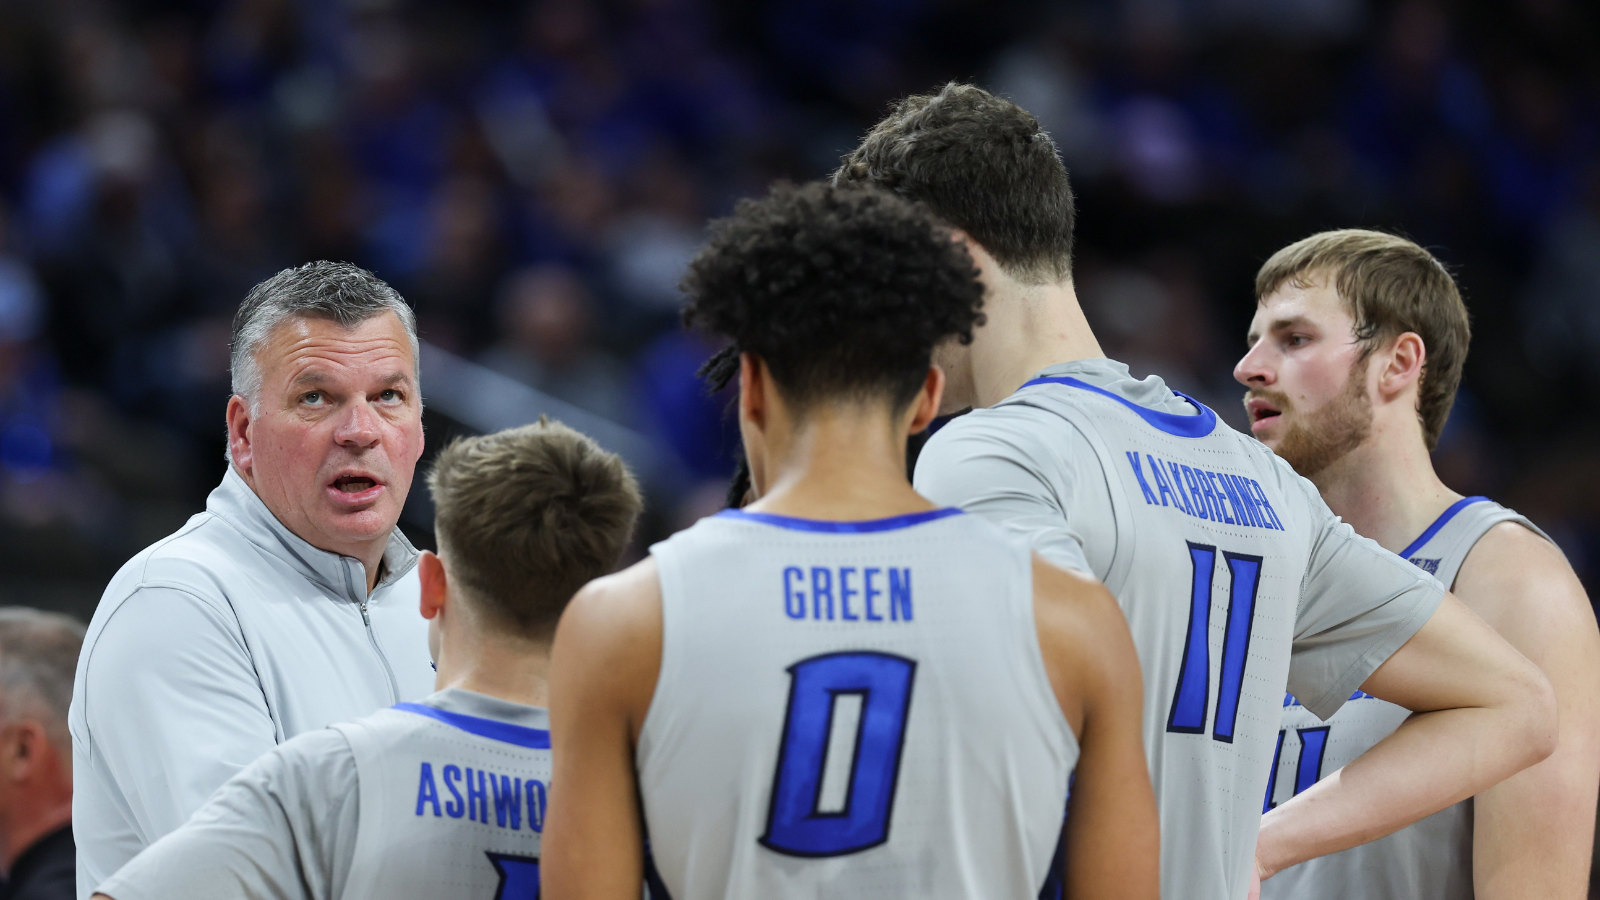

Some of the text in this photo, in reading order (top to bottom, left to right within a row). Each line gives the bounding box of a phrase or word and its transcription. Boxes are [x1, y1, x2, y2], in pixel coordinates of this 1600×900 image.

[1126, 451, 1285, 531] KALKBRENNER
[783, 566, 914, 622] GREEN
[1166, 539, 1263, 744] 11
[757, 649, 918, 859] 0
[416, 762, 551, 833] ASHWO
